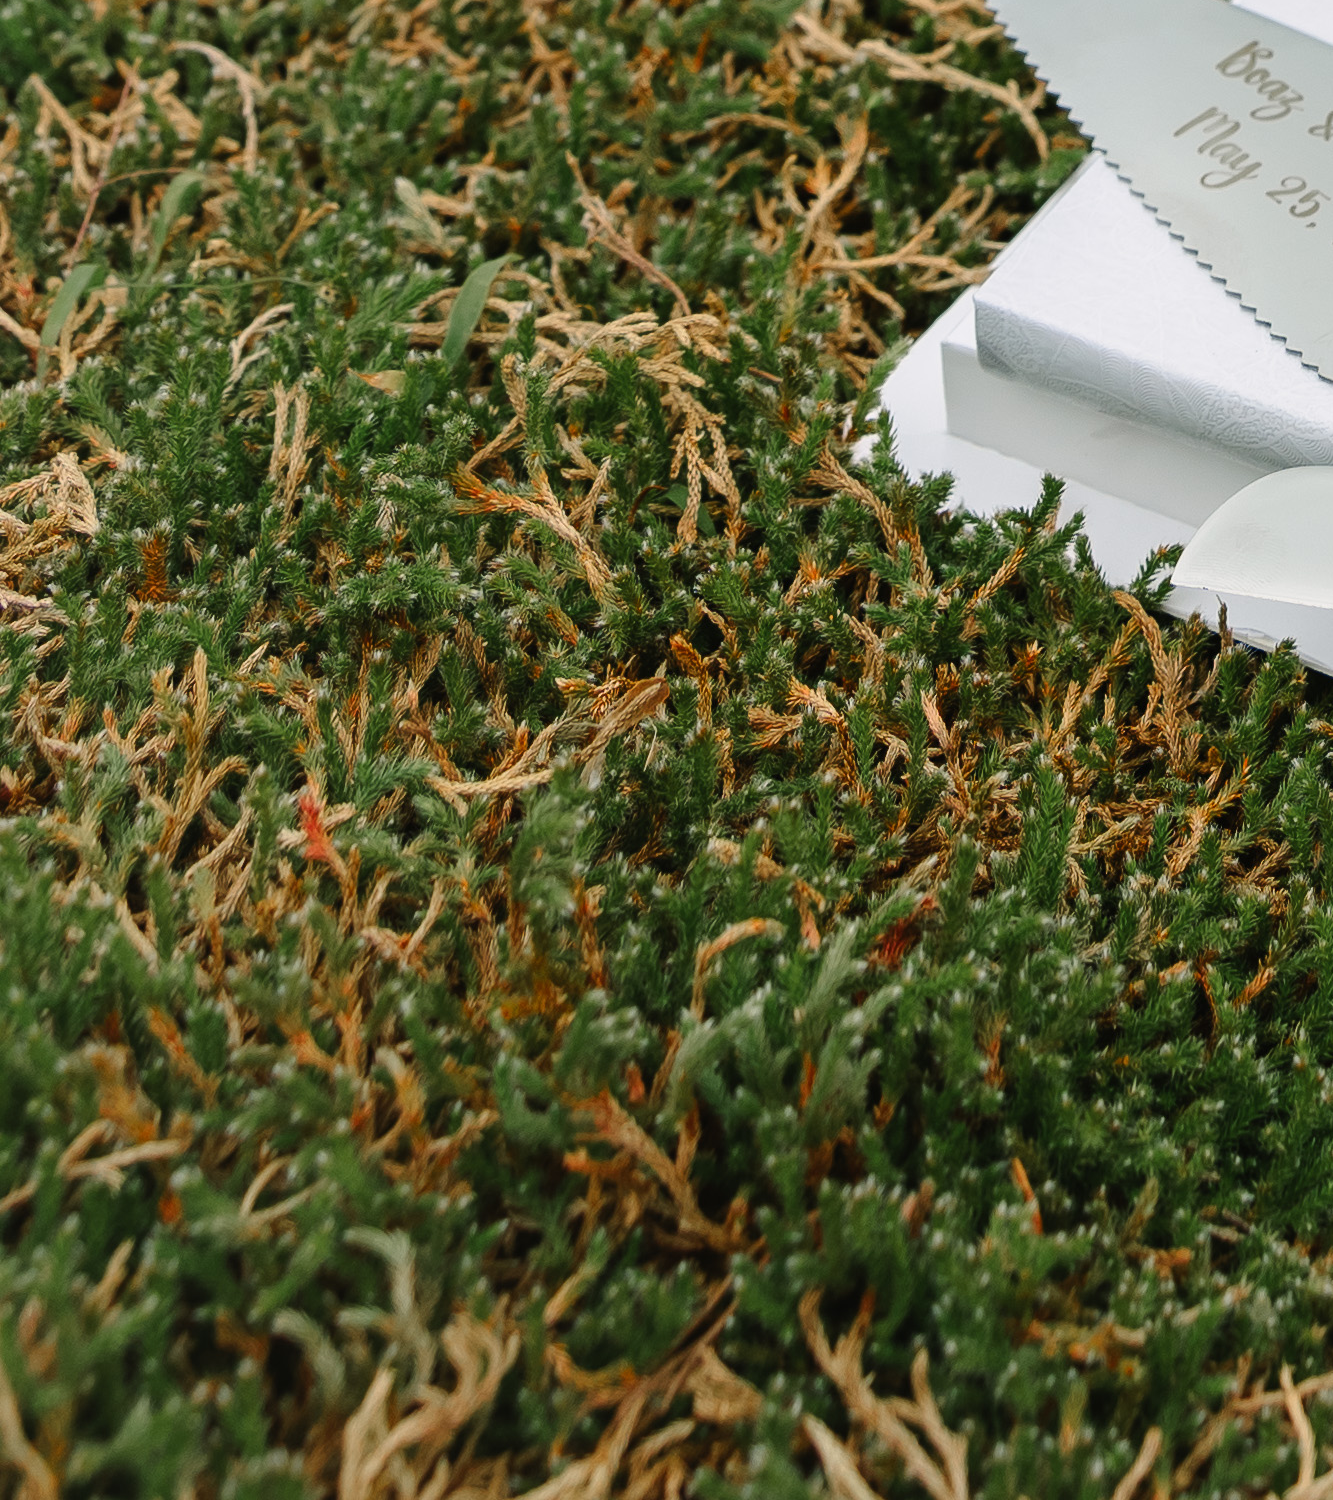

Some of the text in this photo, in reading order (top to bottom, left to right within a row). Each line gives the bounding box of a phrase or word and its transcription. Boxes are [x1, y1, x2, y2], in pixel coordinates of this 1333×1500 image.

[1215, 40, 1304, 122] Boaz
[1173, 106, 1263, 189] May
[1265, 175, 1332, 229] 25,
